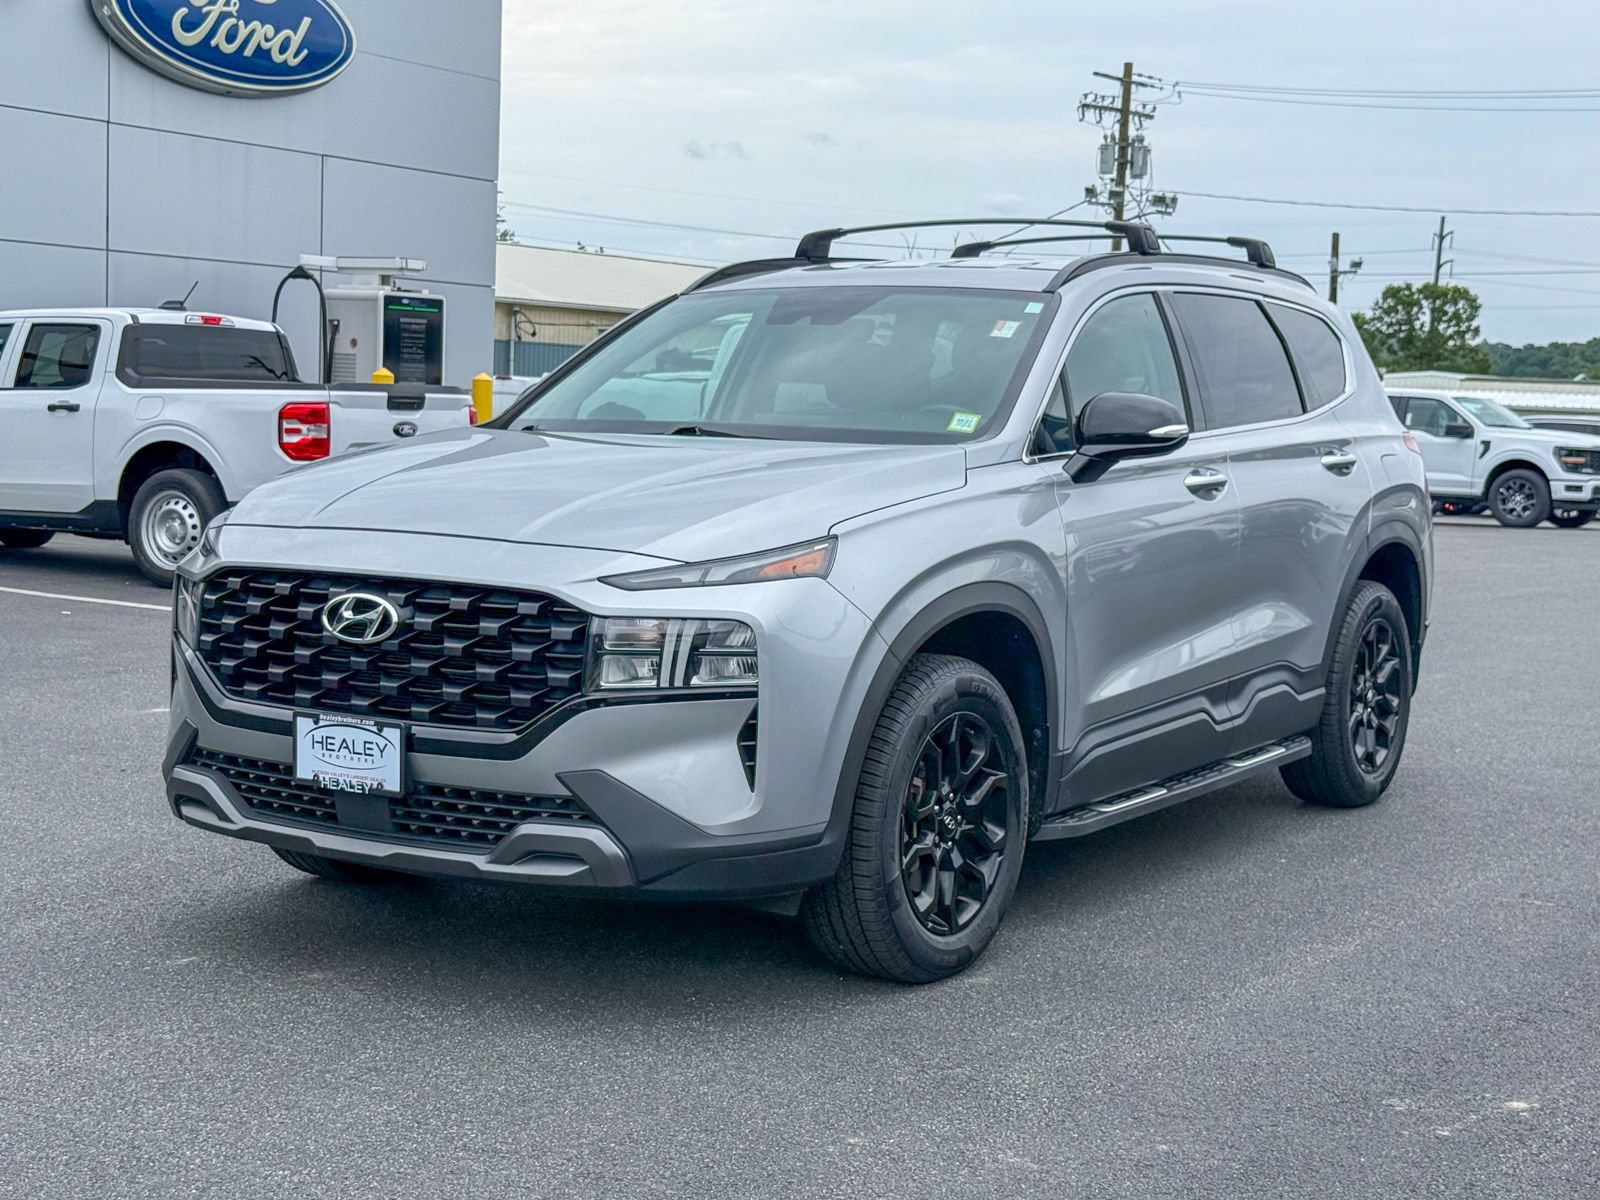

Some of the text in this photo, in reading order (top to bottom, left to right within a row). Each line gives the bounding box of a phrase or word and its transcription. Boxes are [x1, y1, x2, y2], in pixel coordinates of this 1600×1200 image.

[172, 0, 312, 67] Ford
[311, 734, 388, 759] HEALEY
[321, 752, 375, 765] BROTHERS
[320, 776, 373, 795] HEALEY
